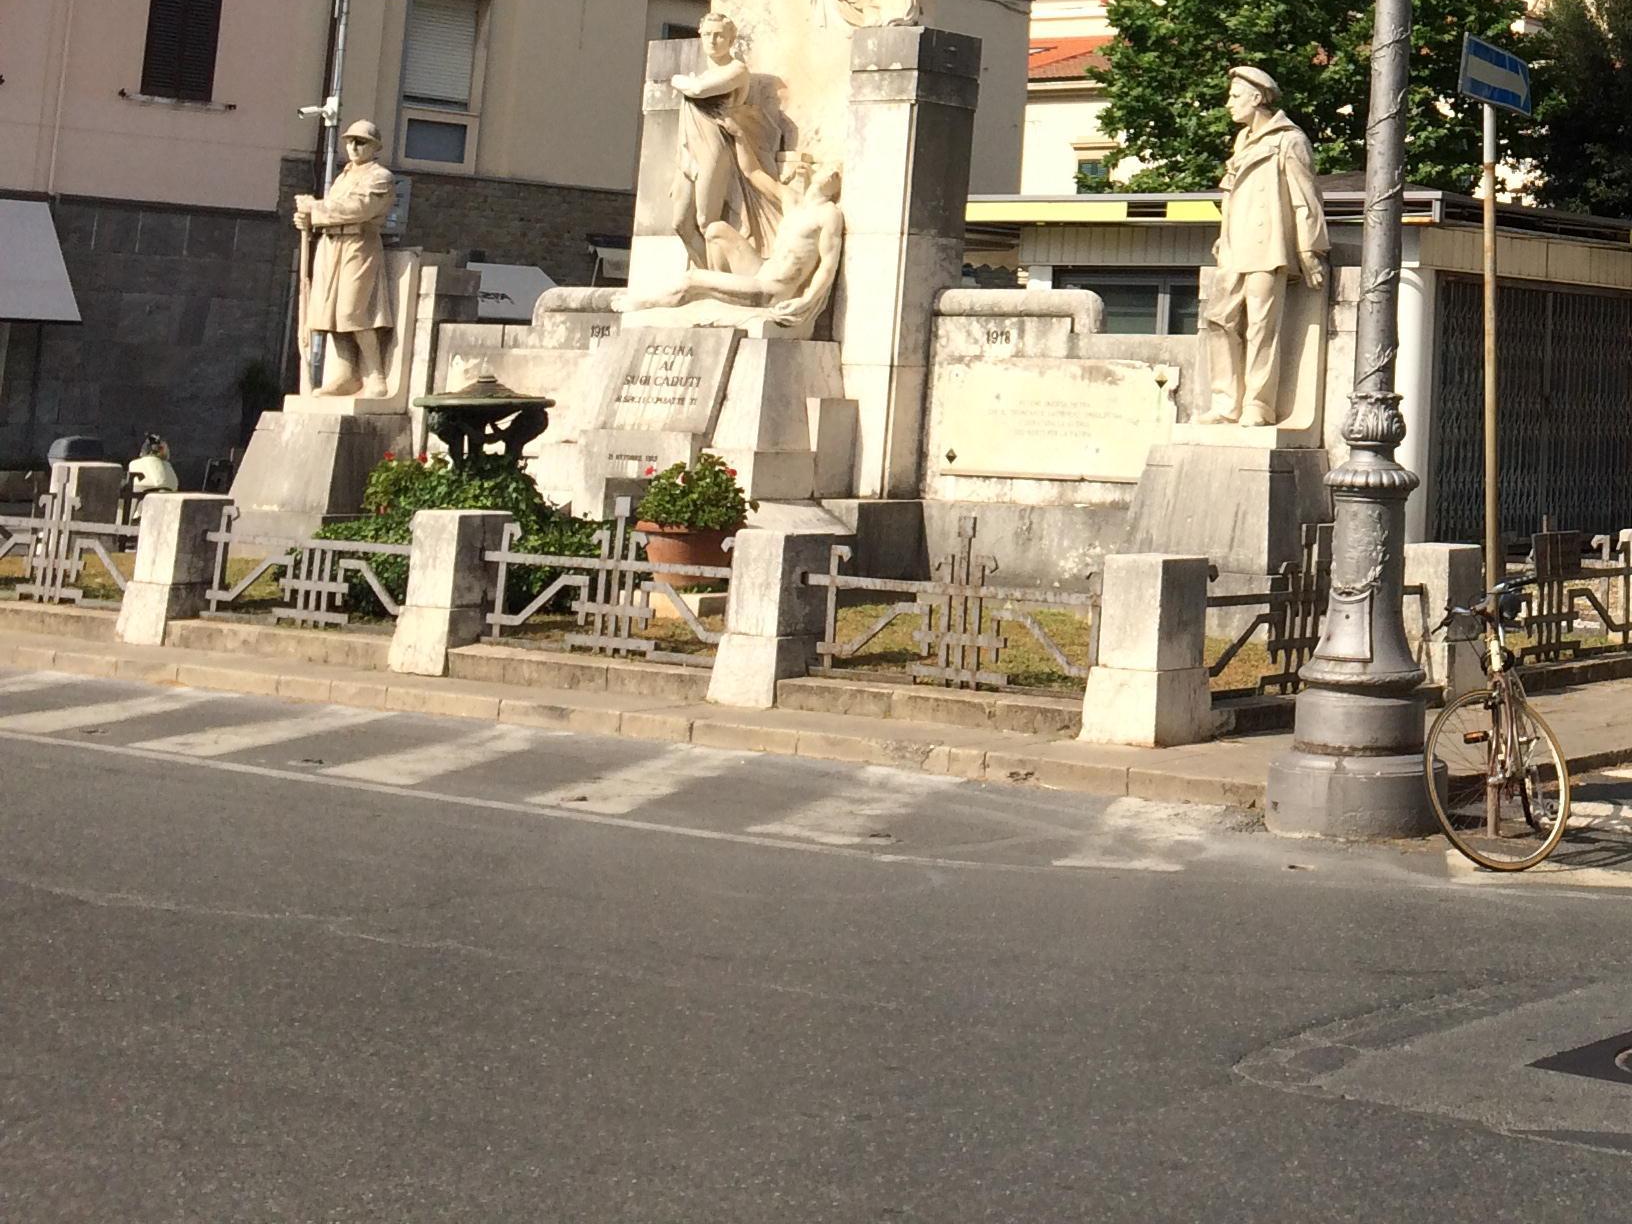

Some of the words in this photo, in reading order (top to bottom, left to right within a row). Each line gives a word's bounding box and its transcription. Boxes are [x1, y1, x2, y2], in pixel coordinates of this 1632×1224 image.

[986, 330, 1011, 345] 1918
[645, 344, 694, 356] CECINA
[623, 375, 651, 386] SUOI
[653, 375, 702, 388] CADUTI
